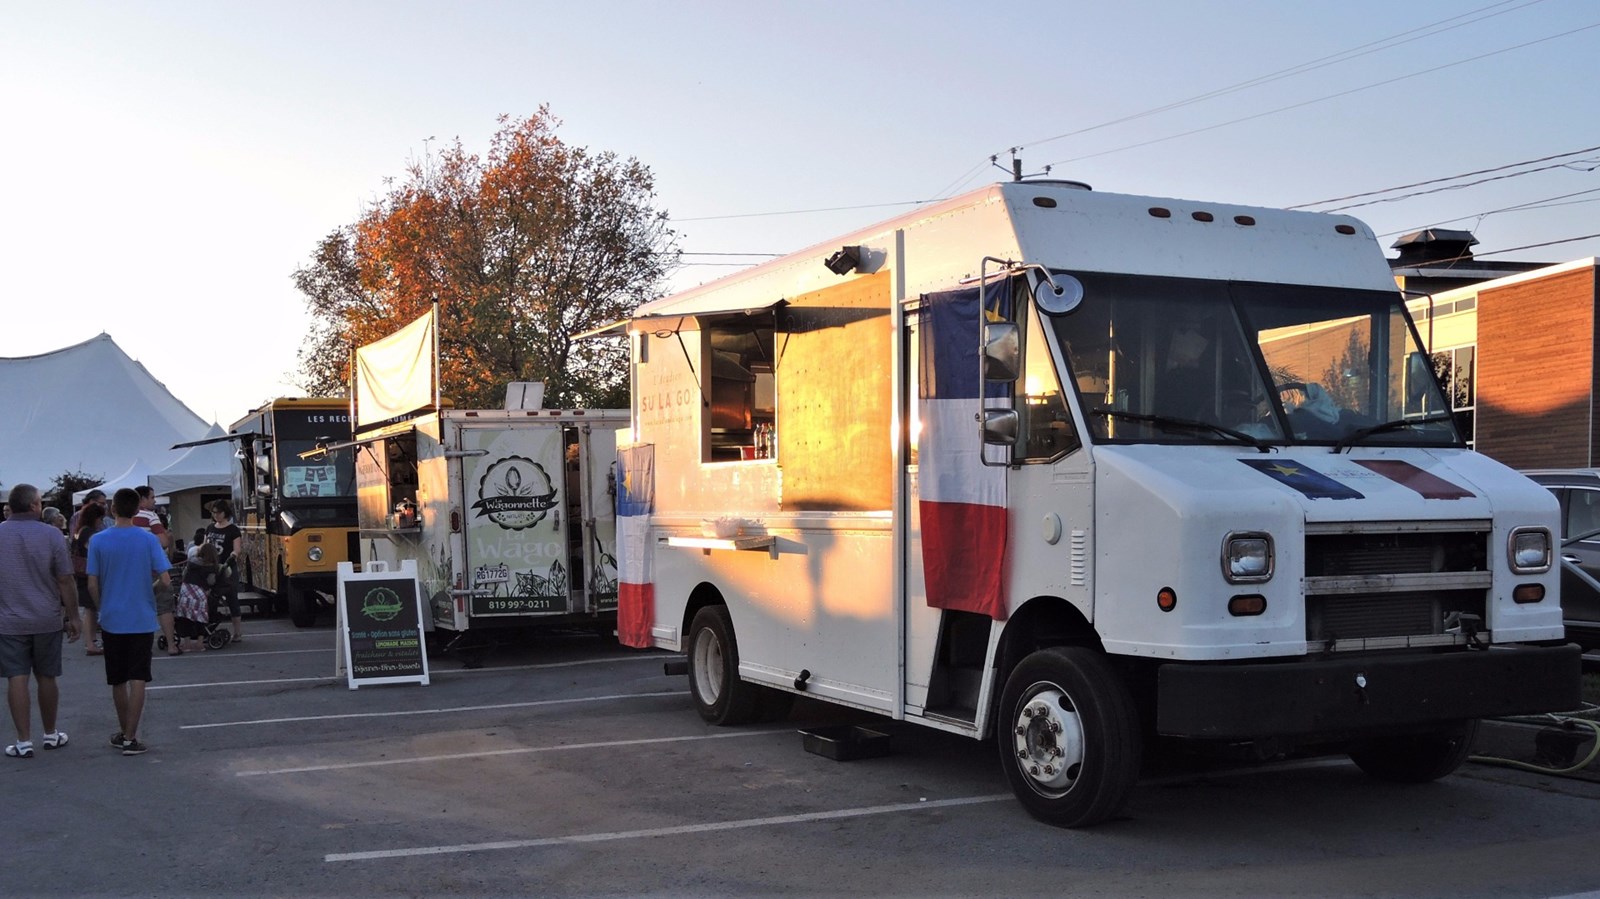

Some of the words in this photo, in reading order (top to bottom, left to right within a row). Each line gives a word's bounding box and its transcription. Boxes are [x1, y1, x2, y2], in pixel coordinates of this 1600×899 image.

[658, 392, 671, 410] LA
[307, 415, 325, 423] LES
[485, 498, 547, 511] Wagonnette
[477, 537, 562, 565] Wago
[488, 600, 506, 609] 819
